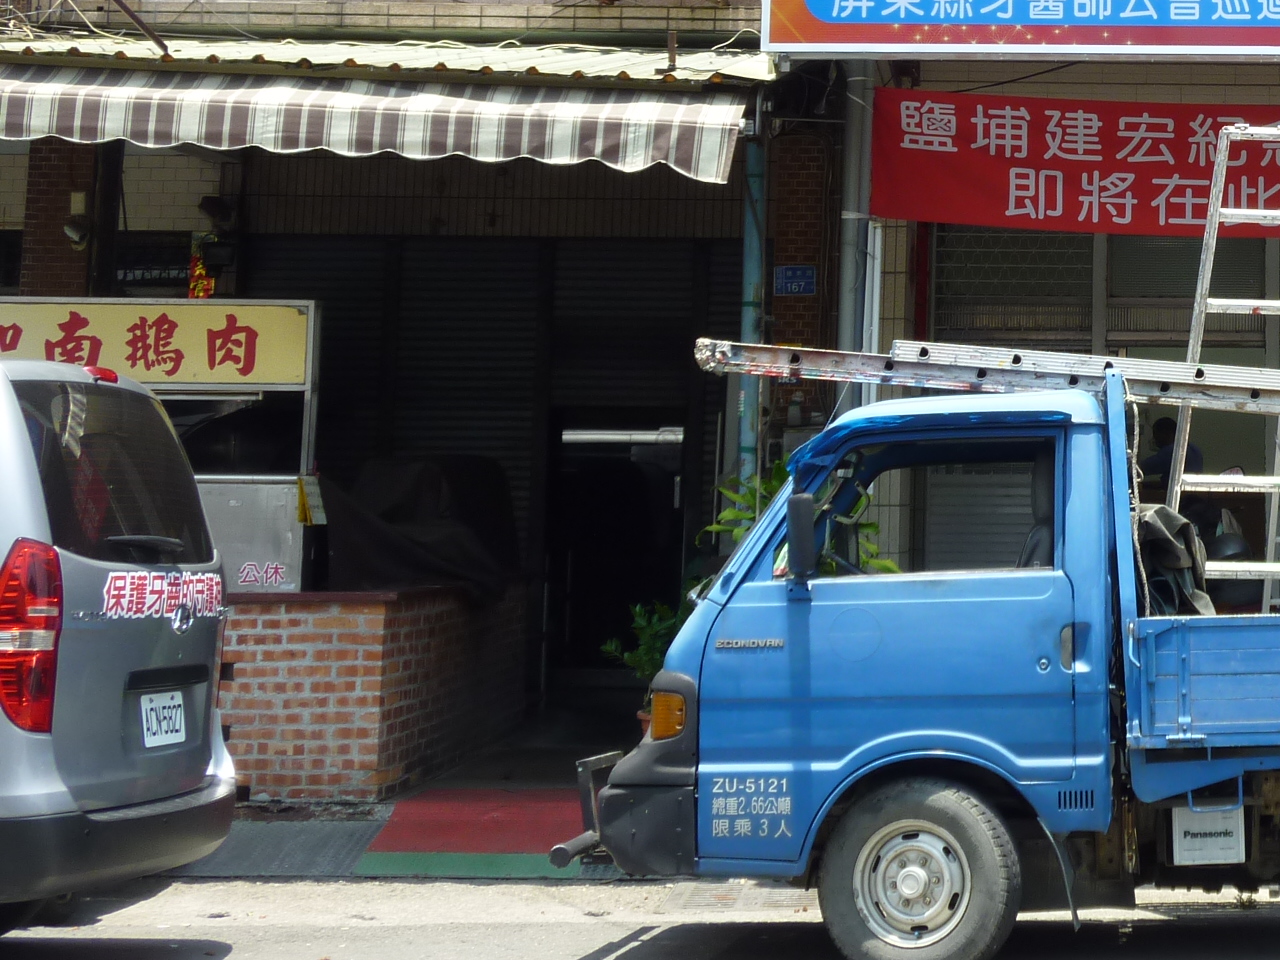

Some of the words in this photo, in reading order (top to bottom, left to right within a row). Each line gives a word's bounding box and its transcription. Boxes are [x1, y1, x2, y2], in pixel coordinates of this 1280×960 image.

[787, 281, 805, 293] 167
[238, 562, 286, 587] 公休
[715, 639, 785, 649] ECONOVAN
[145, 703, 183, 738] ACN-5827
[712, 778, 788, 794] ZU-5121
[1183, 829, 1234, 839] Panasonic
